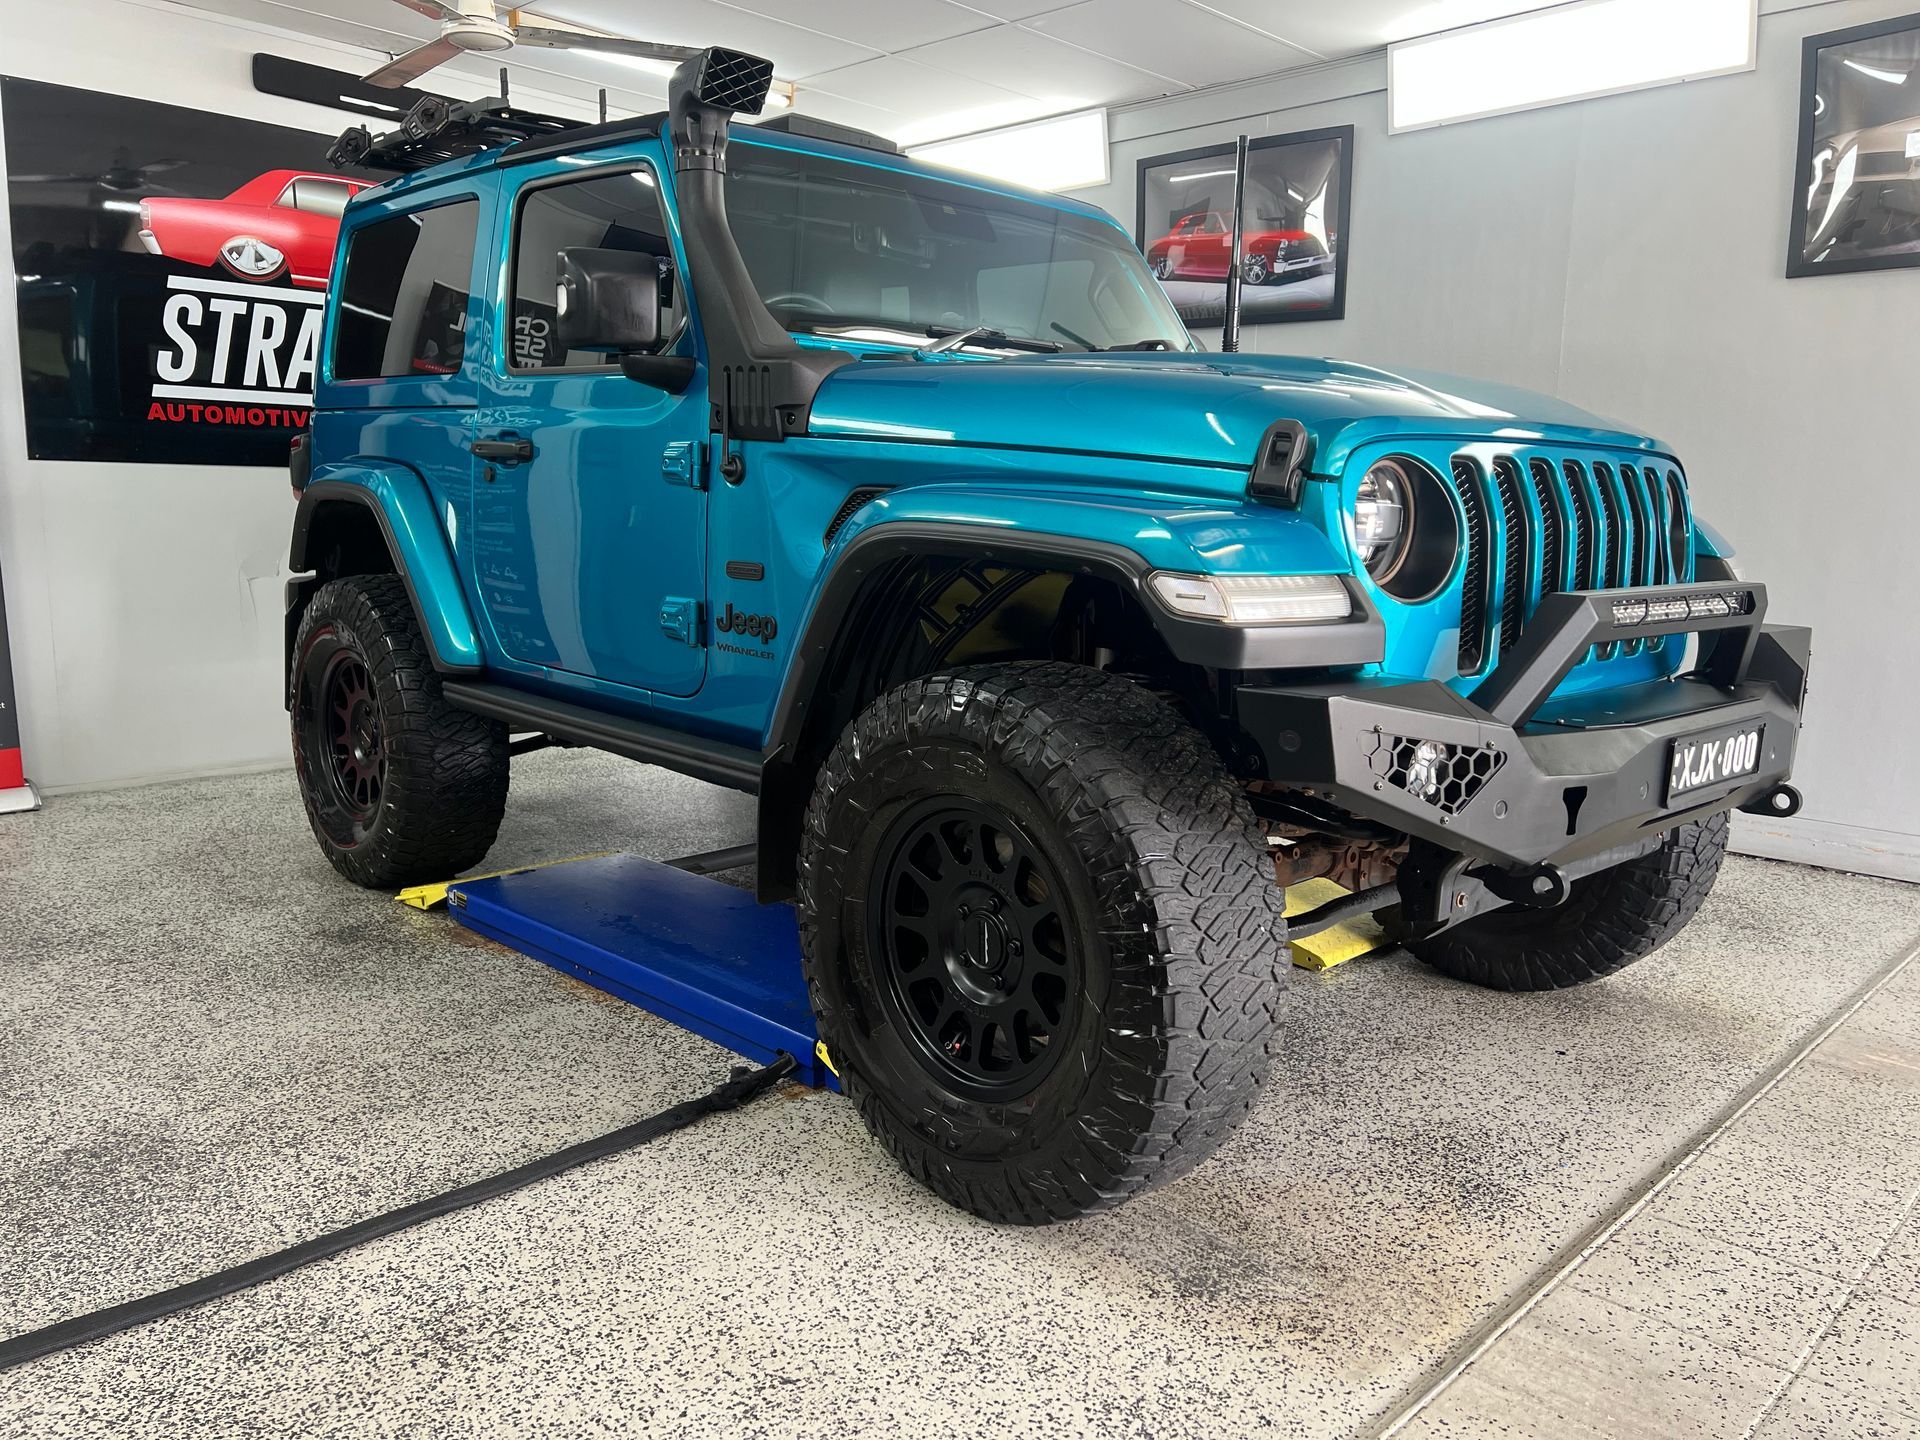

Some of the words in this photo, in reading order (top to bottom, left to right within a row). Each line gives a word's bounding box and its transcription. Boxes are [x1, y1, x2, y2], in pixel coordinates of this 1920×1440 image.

[156, 293, 325, 390] STRA
[716, 602, 778, 645] Jeep
[716, 641, 776, 661] WRANGLER
